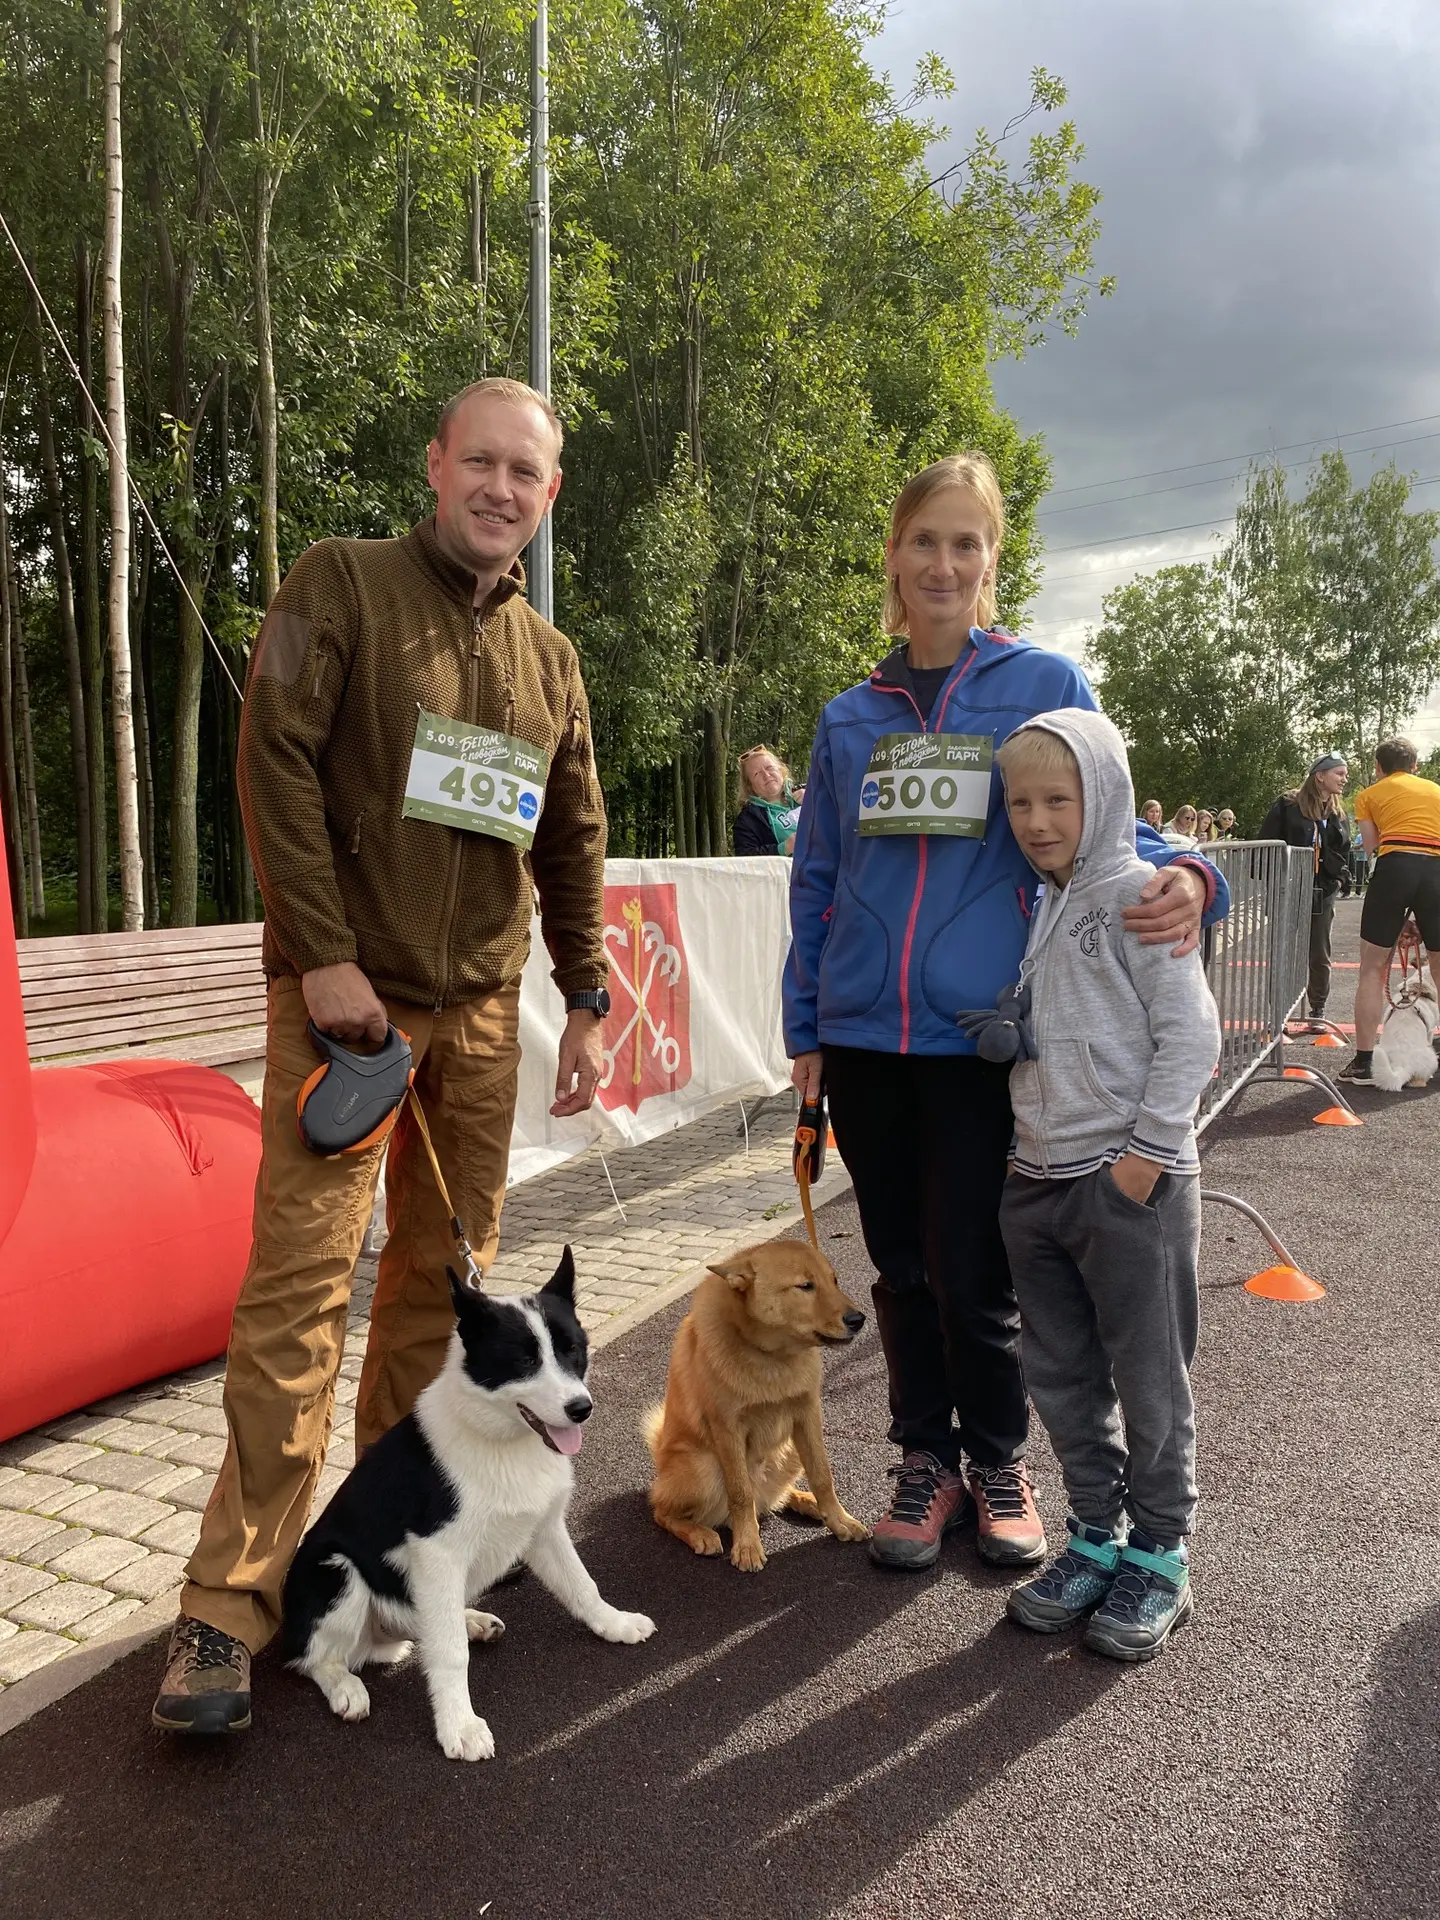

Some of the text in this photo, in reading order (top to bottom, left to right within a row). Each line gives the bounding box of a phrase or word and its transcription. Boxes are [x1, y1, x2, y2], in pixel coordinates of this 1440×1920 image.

[426, 729, 455, 747] 5.09
[514, 756, 539, 775] ПАРК
[946, 751, 980, 762] ПАРК
[439, 766, 520, 816] 493
[878, 775, 958, 811] 500
